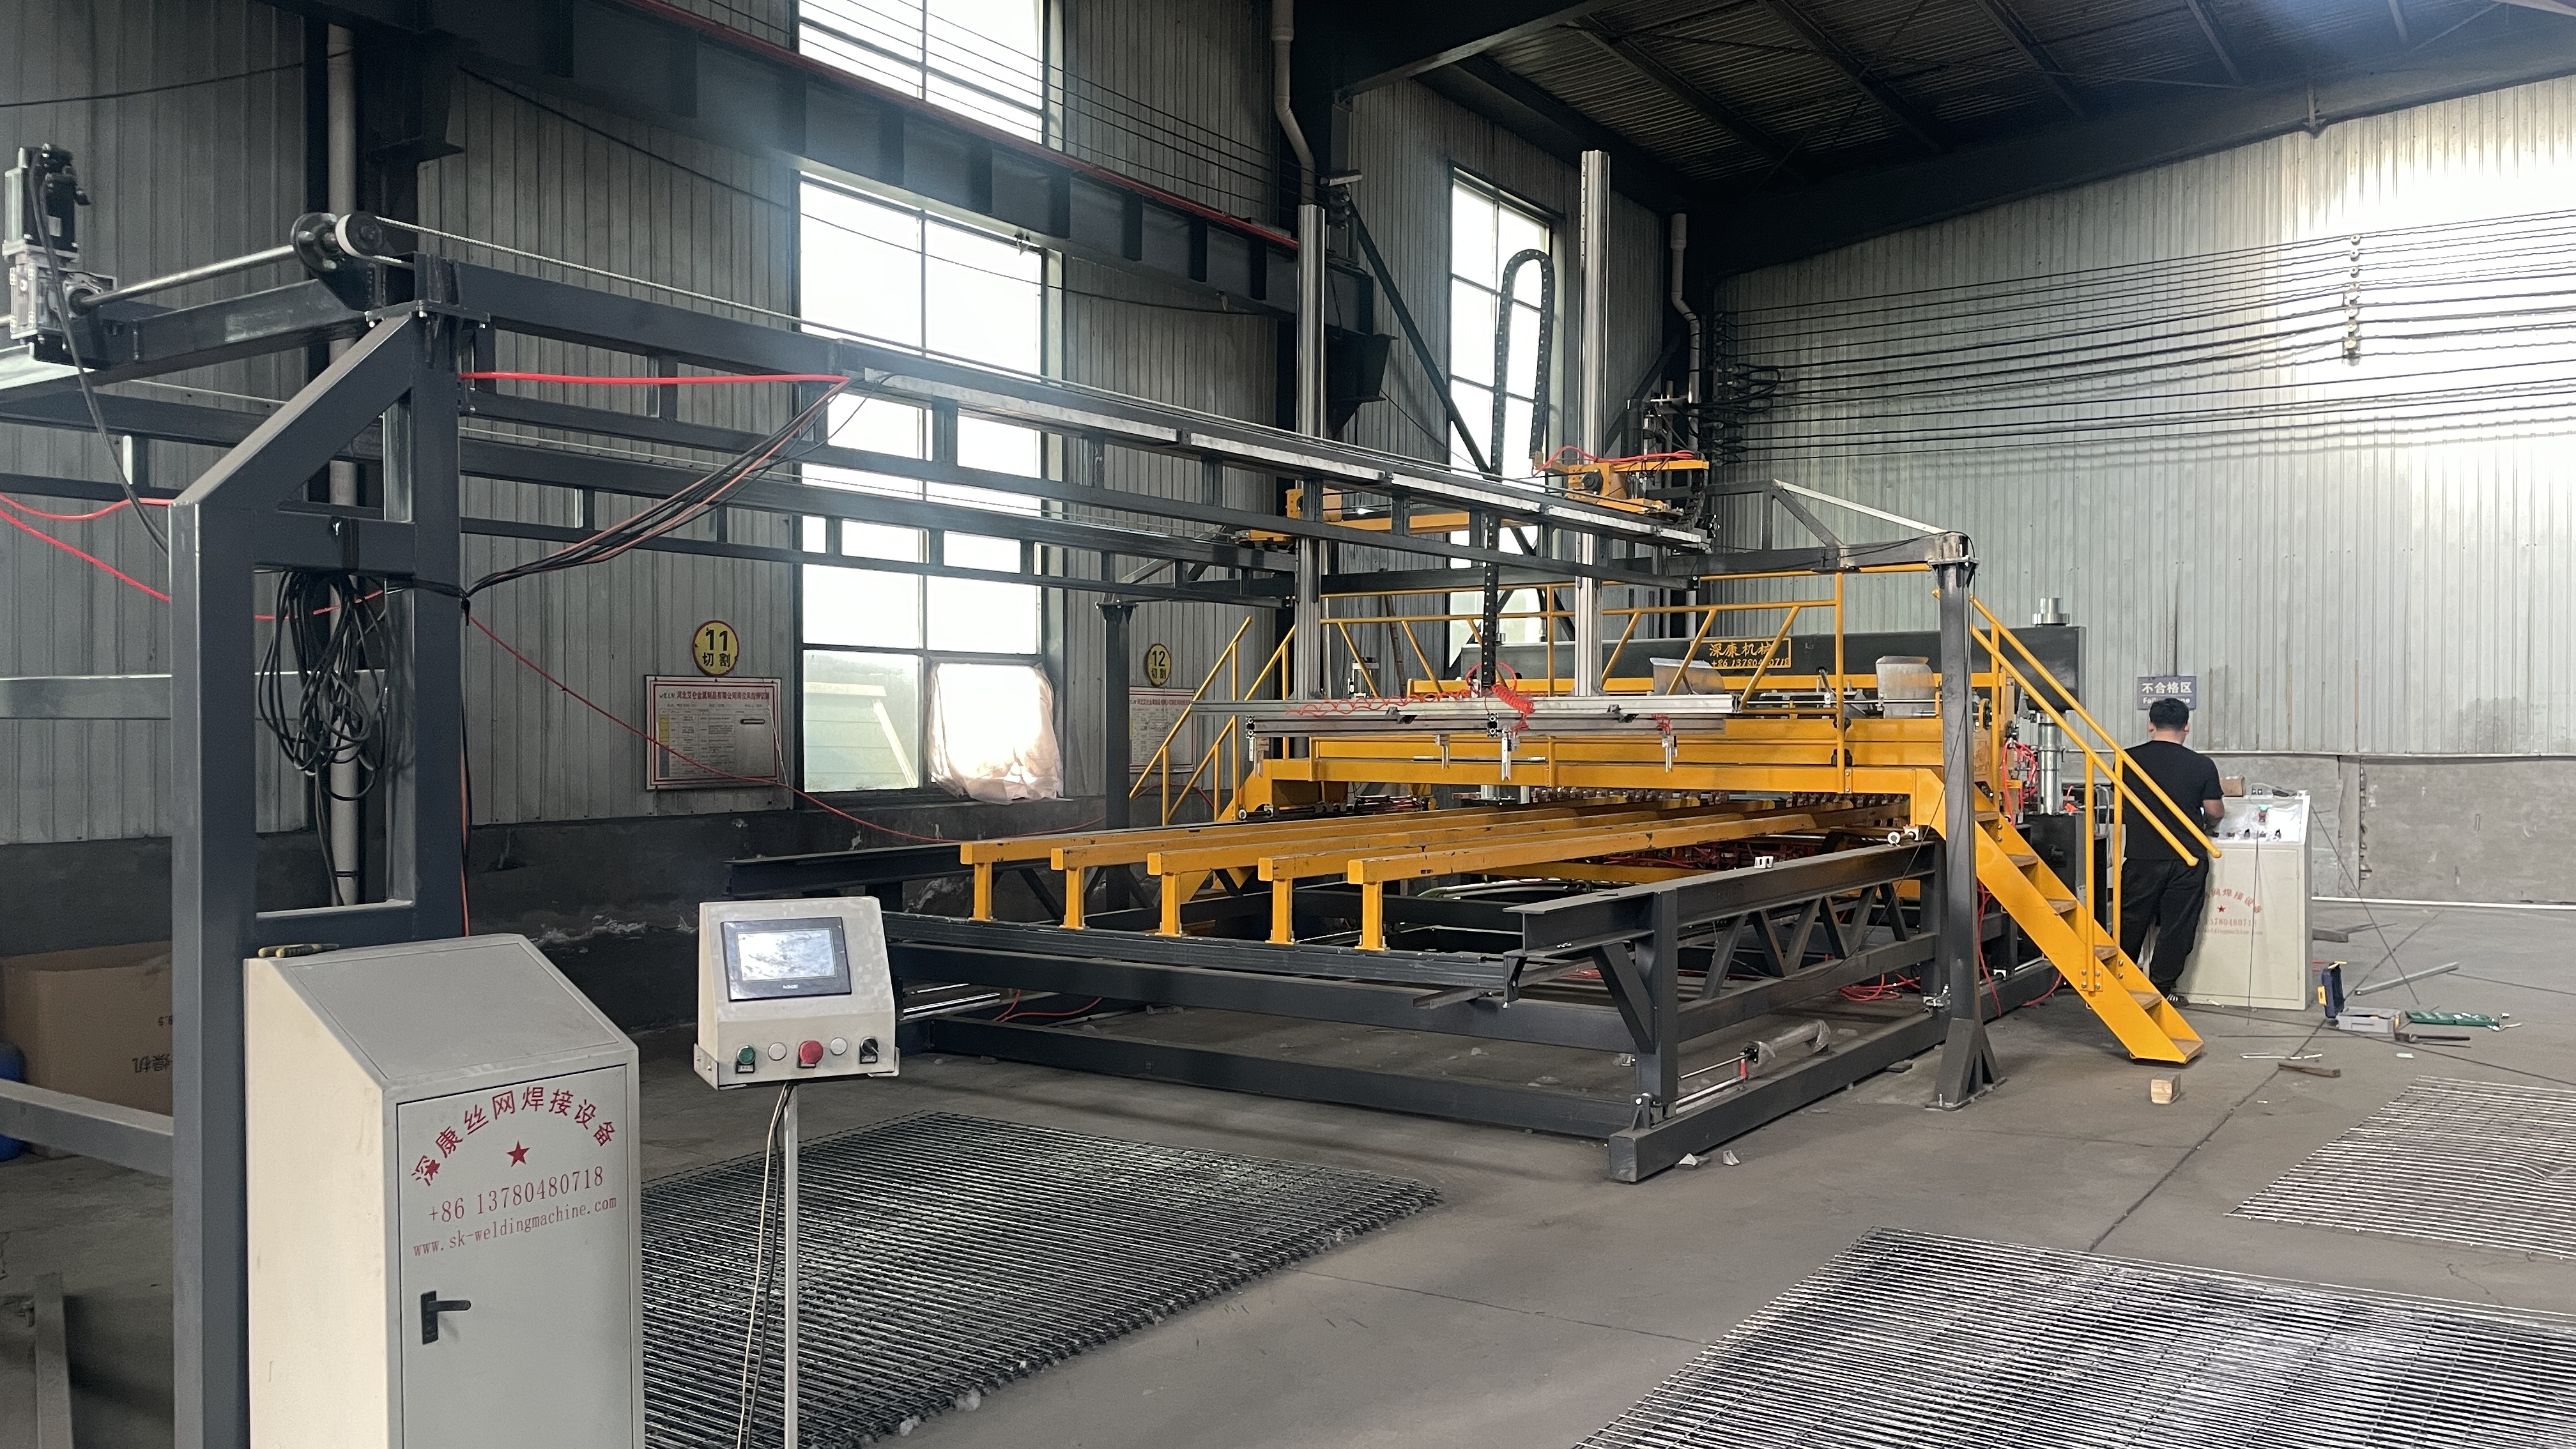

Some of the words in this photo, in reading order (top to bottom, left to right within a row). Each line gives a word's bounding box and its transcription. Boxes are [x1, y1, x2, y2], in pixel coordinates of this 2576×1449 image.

[705, 629, 728, 651] 11
[702, 652, 731, 667] 切割
[1152, 650, 1165, 667] 12
[1712, 659, 1728, 667] +86
[1731, 657, 1789, 667] 1378040718
[2142, 681, 2192, 694] 不合格区
[429, 1197, 465, 1223] +86
[477, 1166, 604, 1215] 13780480718
[413, 1196, 617, 1257] www.sk-weldingmachine.com
